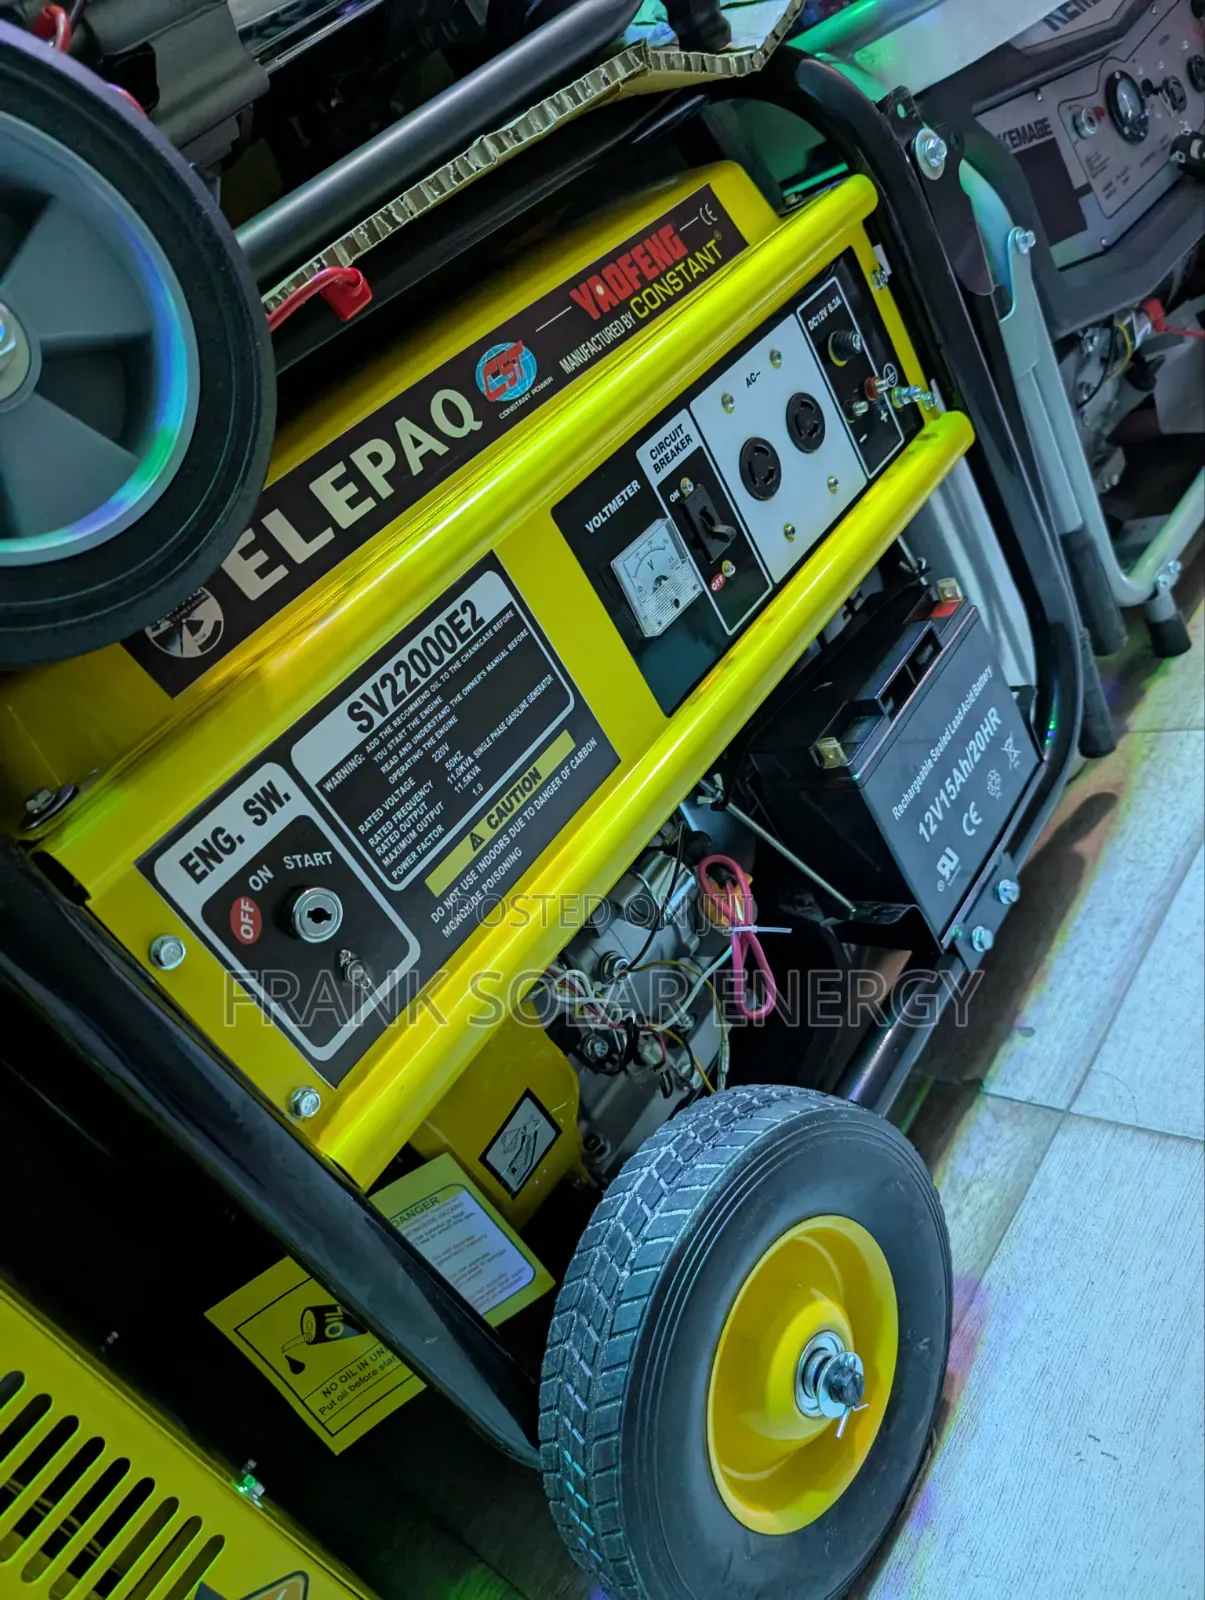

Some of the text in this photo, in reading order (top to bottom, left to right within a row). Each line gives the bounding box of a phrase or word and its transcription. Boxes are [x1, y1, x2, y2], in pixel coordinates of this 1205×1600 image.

[569, 223, 688, 320] YAOFENG
[559, 239, 722, 375] MANUFACTURED BY CONSTANT
[808, 306, 828, 331] DC12V
[483, 340, 524, 402] CST
[499, 376, 553, 419] CONSTANT POWER
[650, 424, 685, 460] CIRCUIT
[653, 434, 693, 474] BREAKER
[221, 388, 483, 601] ELEPAQ
[585, 480, 641, 534] VOLTMETER
[669, 490, 680, 503] ON
[711, 574, 724, 591] OFF
[322, 753, 366, 793] WARNING:
[365, 737, 380, 754] ADD
[378, 724, 393, 740] THE
[392, 690, 431, 729] RECOMMEND
[430, 680, 442, 692] OIL
[440, 672, 450, 683] TO
[448, 660, 462, 674] THE
[493, 609, 515, 632] BEFORE
[347, 599, 485, 734] SV22000E2
[380, 628, 530, 774] READ AND UNDERSTAND THE OWNER'S MANUAL BEFORE
[372, 695, 444, 763] YOU START THE ENGINE
[388, 714, 459, 785] OPERATING THE ENGINE
[892, 664, 994, 821] Rechargeable Sealed Lead Acid Battery
[358, 741, 450, 835] RATED VOLTAGE 220V
[368, 750, 464, 848] RATED FREQUENCY 50HZ
[375, 673, 554, 856] RATED OUTPUT 11.0KVA SINGLE PHASE GASOLINE GENERATOR
[486, 766, 542, 830] CAUTION
[918, 706, 1003, 842] 12V15Ah/20HR
[178, 779, 292, 885] ENG. SW.
[381, 765, 482, 868] MAXIMUM OUTPUT 11.5KVA
[391, 782, 484, 880] POWER FACTOR 1.0
[430, 736, 598, 924] DO NOT USE INDOORS DUE TO DANGER OF CARBON
[248, 865, 275, 891] ON
[283, 851, 333, 870] START
[441, 846, 523, 938] MONOXIDE POISONING
[240, 898, 255, 940] OFF
[390, 1196, 440, 1228] DANGER
[325, 1305, 344, 1339] OIL
[319, 1354, 398, 1416] Put oil before star
[322, 1347, 389, 1398] NO OIL IN UN
